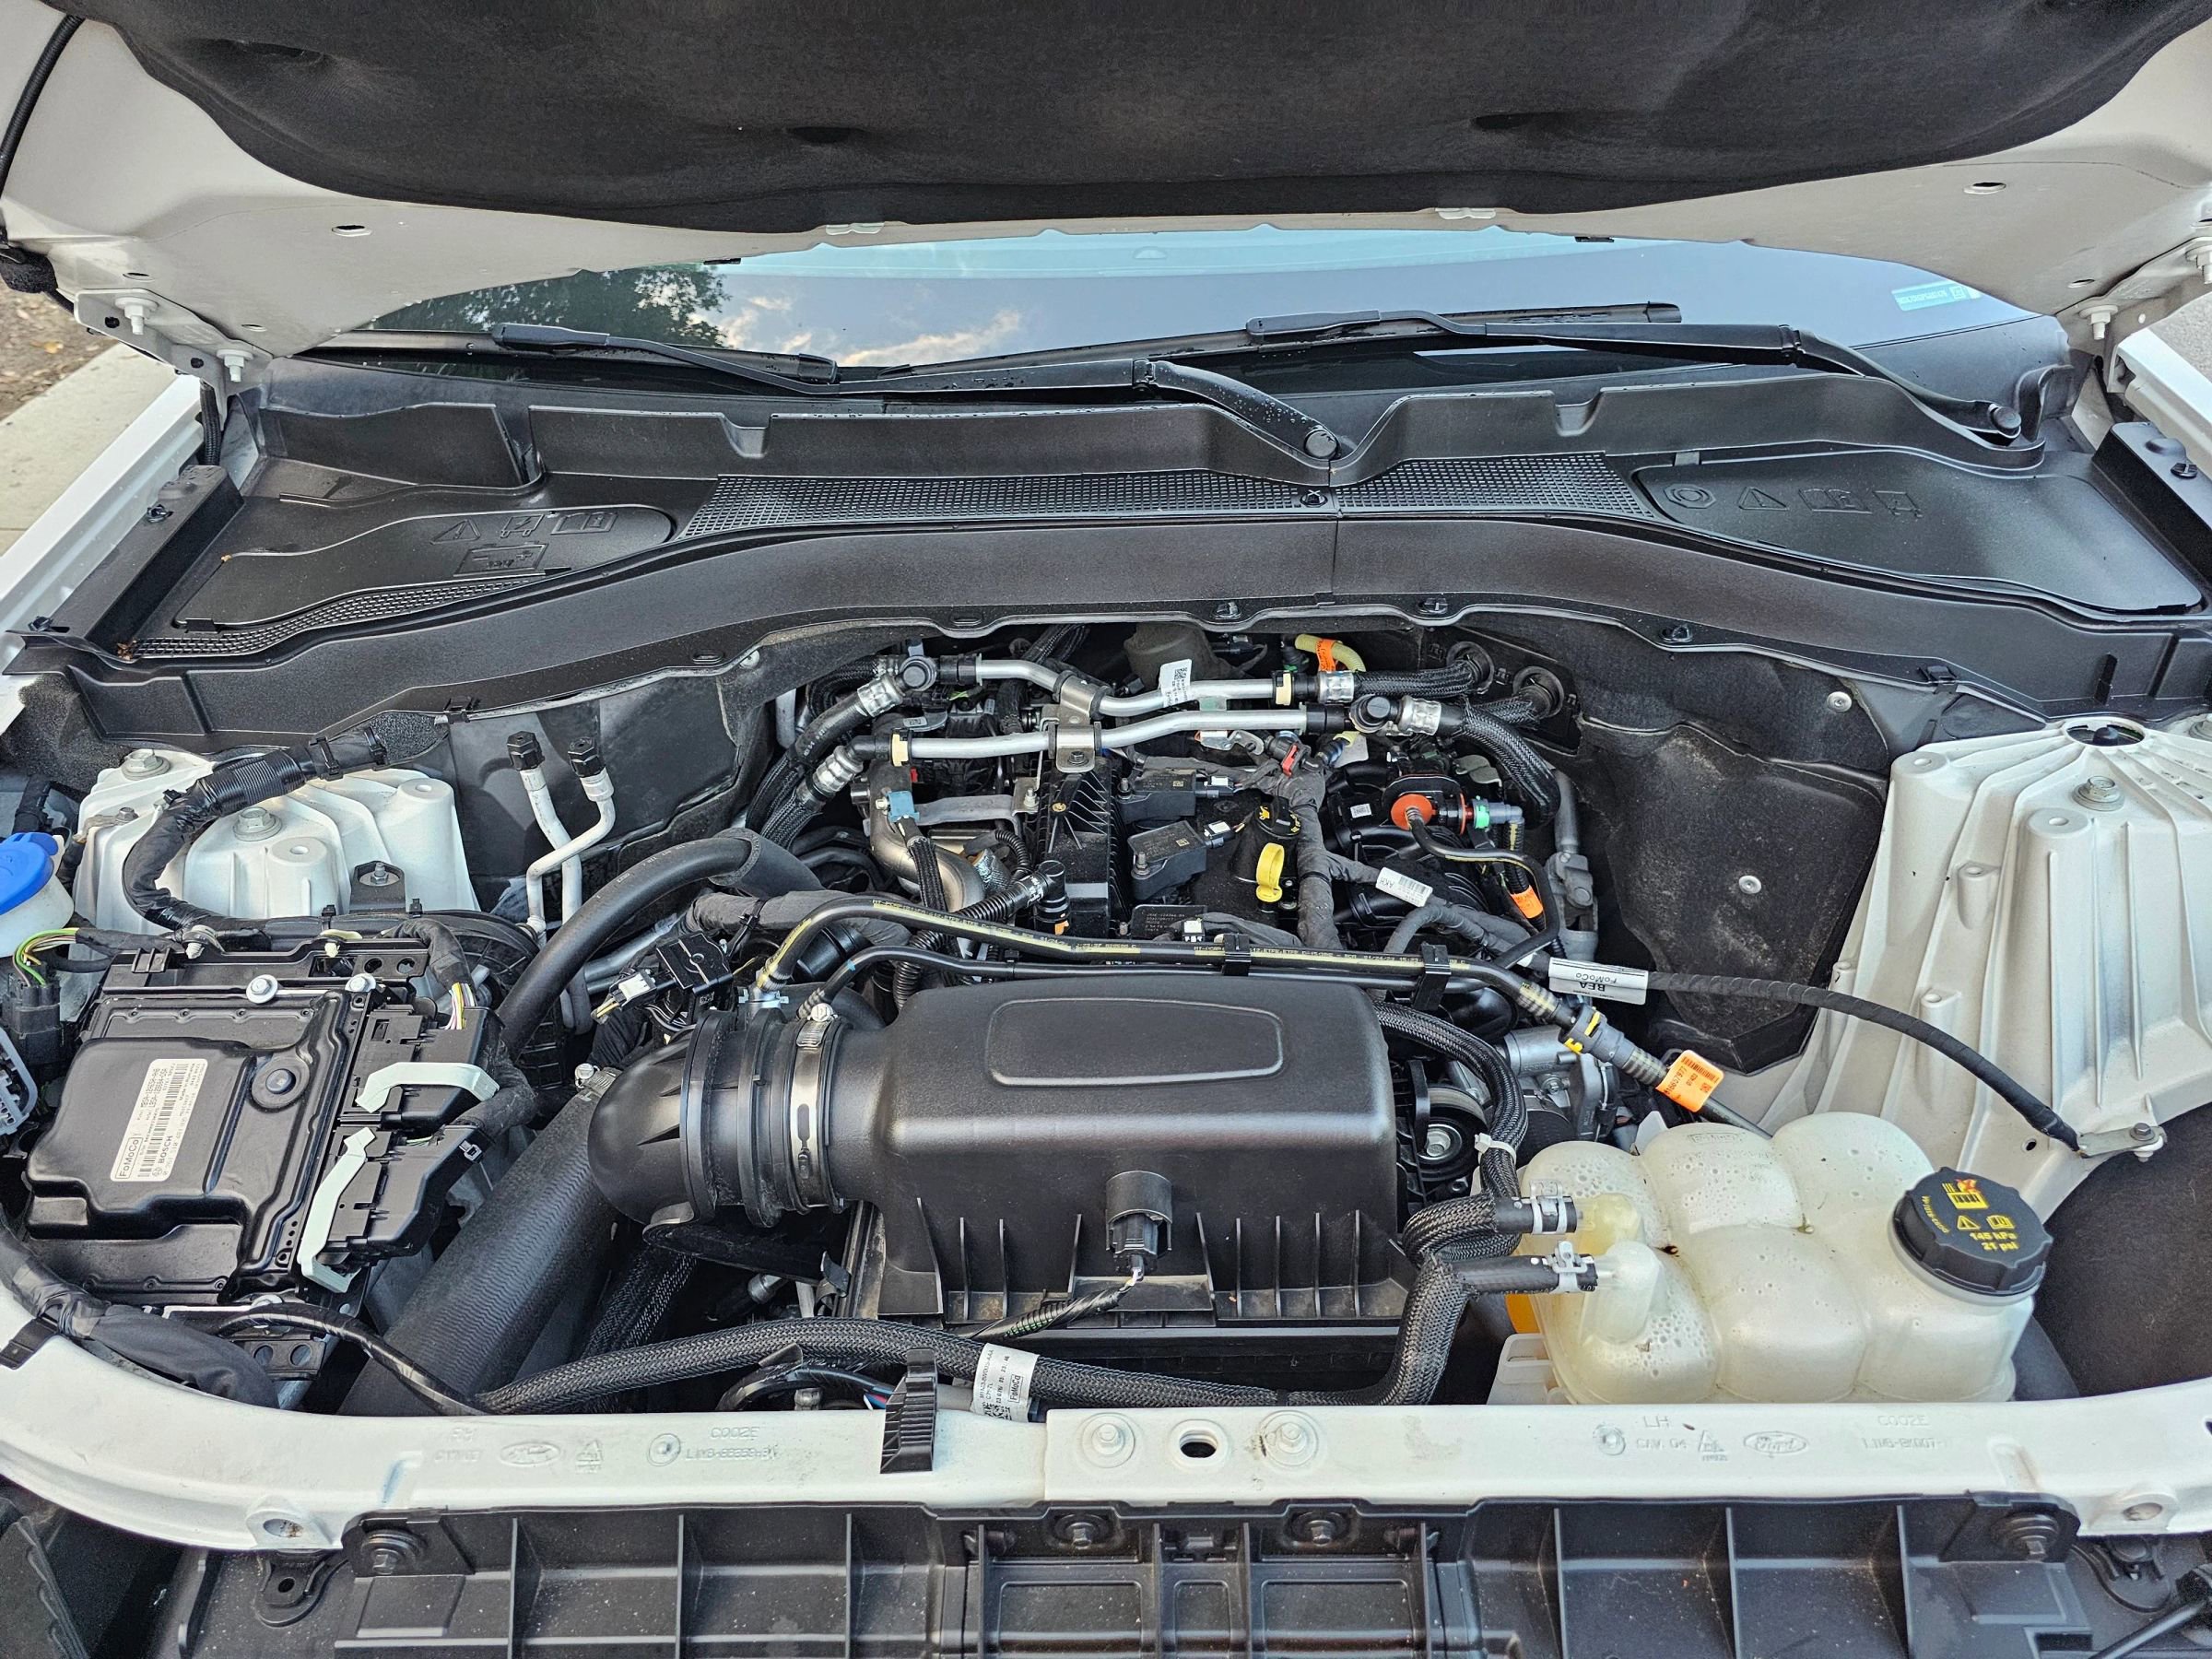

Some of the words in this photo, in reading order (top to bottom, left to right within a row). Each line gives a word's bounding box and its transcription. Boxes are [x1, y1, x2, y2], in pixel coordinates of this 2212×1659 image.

[1576, 972, 1618, 984] FoMoCo
[1579, 981, 1606, 993] BEA
[119, 1139, 140, 1177] FoMoCo
[158, 1135, 174, 1164] BOSCH
[1009, 1374, 1021, 1401] FoMoCo
